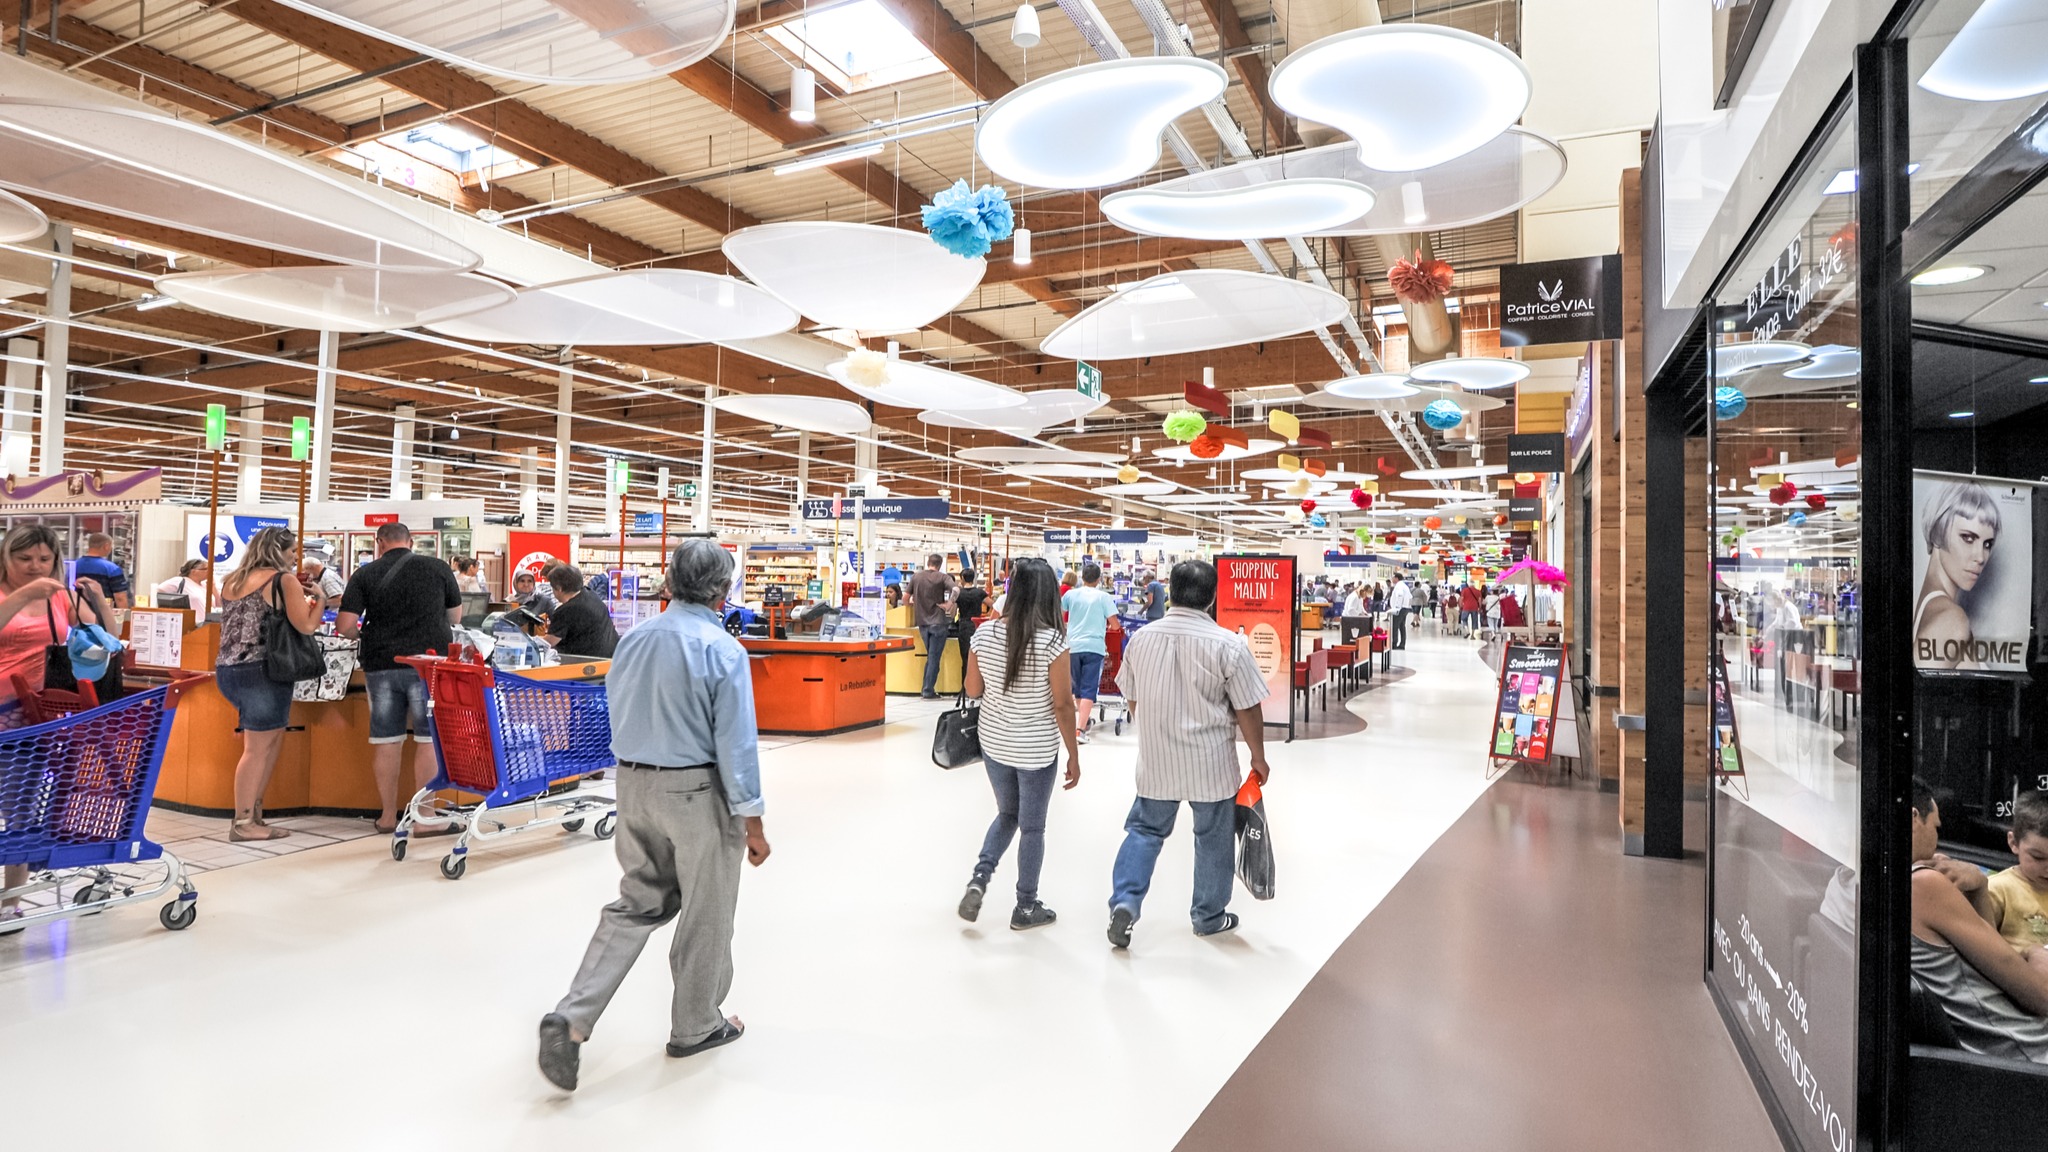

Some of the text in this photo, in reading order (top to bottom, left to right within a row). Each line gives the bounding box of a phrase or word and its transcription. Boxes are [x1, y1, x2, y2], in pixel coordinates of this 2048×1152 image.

[1818, 237, 1843, 289] 32€
[871, 504, 902, 515] unique
[1230, 562, 1279, 580] SHOPPING
[1234, 582, 1267, 600] MALIN
[1917, 638, 2023, 664] BLONDME
[1509, 658, 1559, 669] Smoothies
[840, 683, 847, 692] La
[1714, 918, 1731, 964] AVEC
[1733, 951, 1745, 987] OU
[1748, 974, 1770, 1031] SANS
[1784, 981, 1809, 1034] -20%
